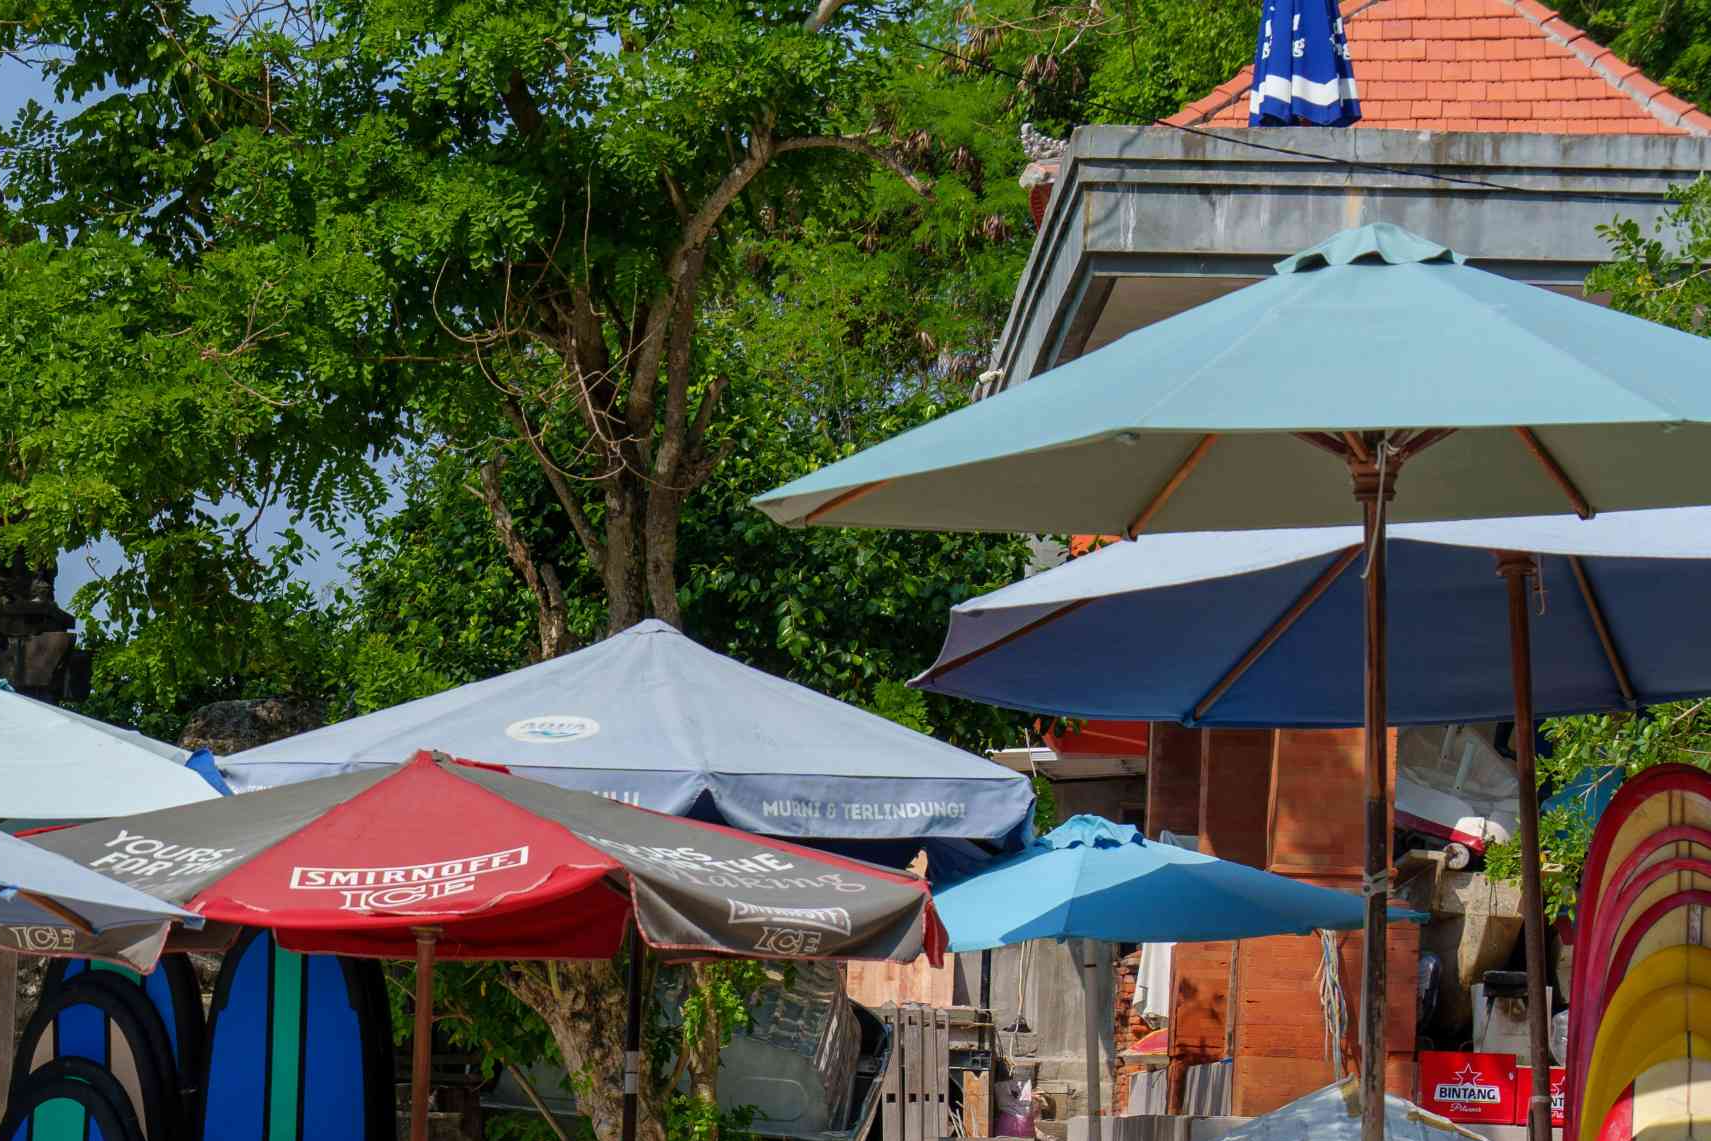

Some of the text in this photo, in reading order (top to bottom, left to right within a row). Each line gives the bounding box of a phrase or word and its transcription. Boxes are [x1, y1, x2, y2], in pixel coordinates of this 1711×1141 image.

[763, 800, 820, 819] MURNI
[843, 801, 966, 820] TERLINDUNGI
[339, 875, 476, 911] ICE
[8, 925, 75, 951] ICE
[753, 926, 822, 955] ICE
[1439, 1086, 1496, 1100] BINTANG
